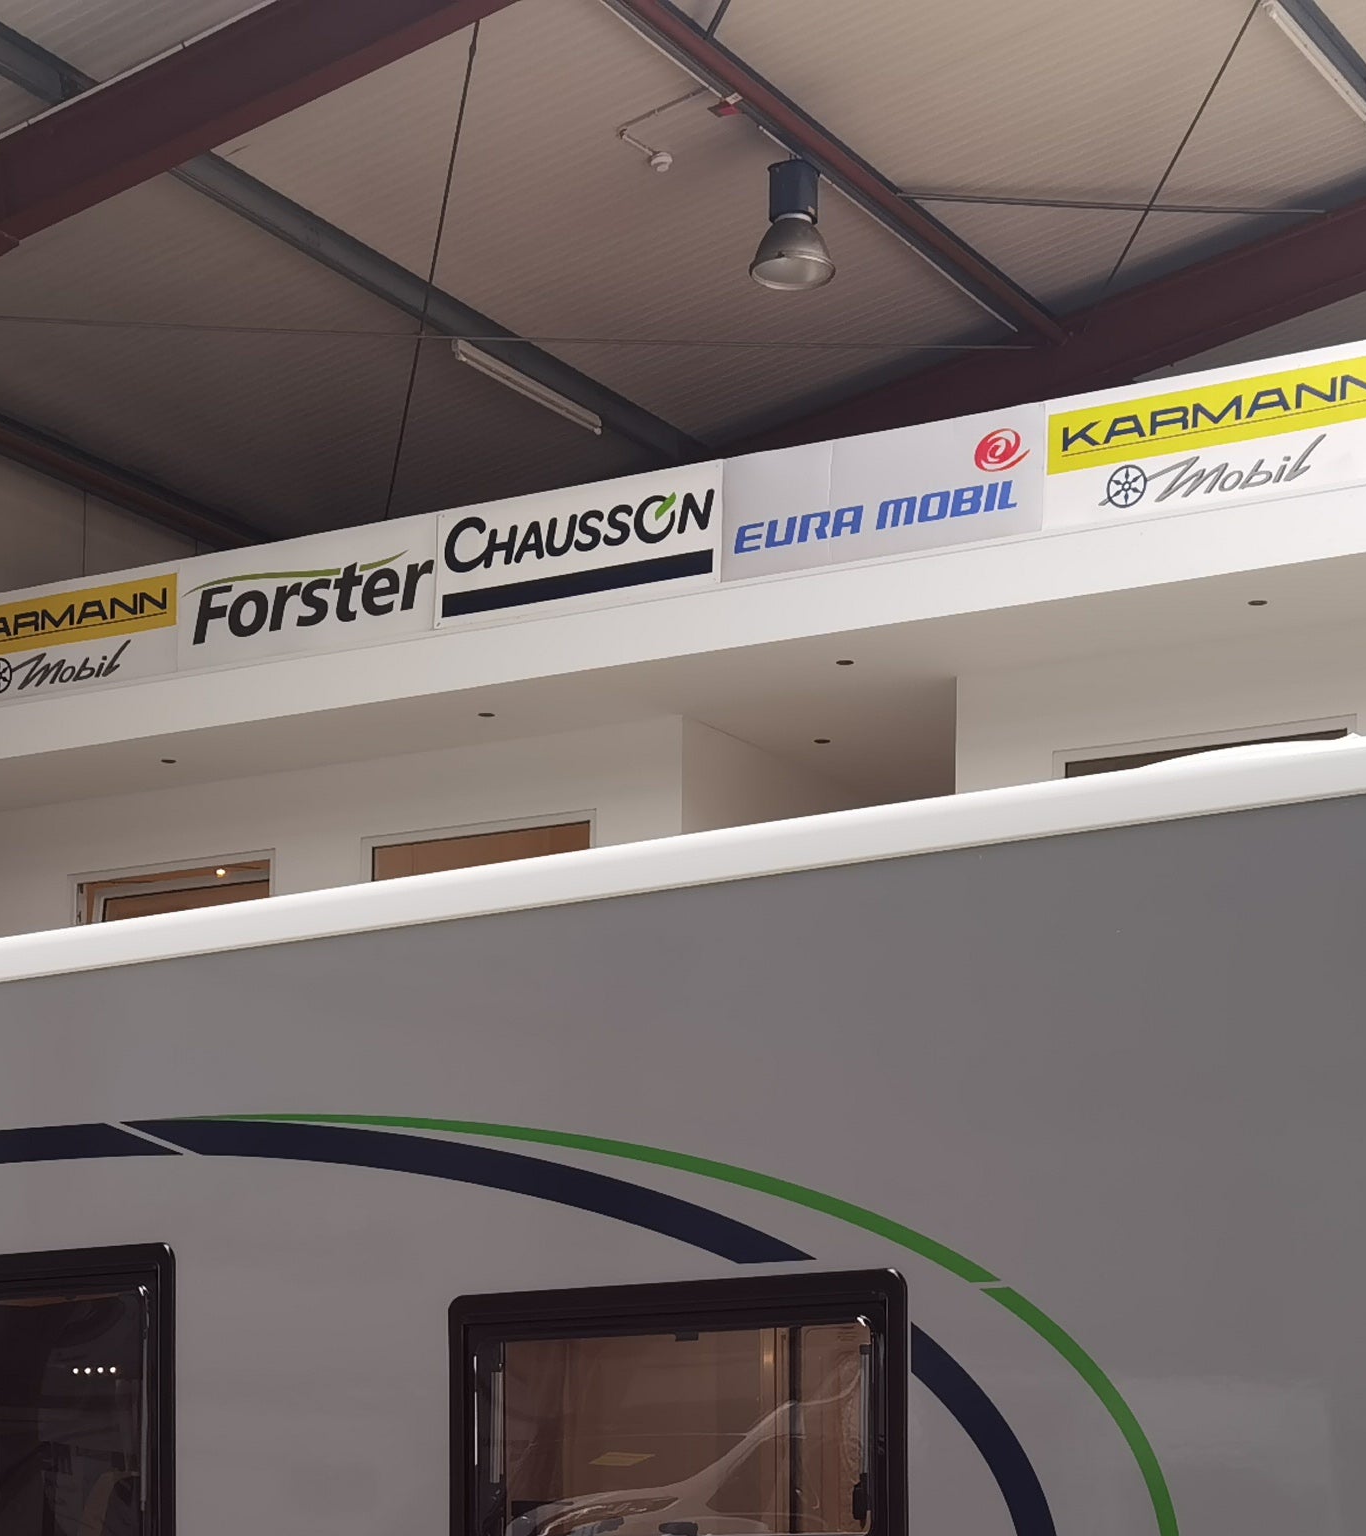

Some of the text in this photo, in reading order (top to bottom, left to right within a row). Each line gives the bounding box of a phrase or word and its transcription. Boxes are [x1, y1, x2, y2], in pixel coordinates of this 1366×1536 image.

[1154, 433, 1327, 503] Mobil
[444, 488, 715, 573] CHAUSSON
[733, 479, 1018, 555] EURA MOBIL
[192, 559, 434, 645] Forster
[17, 640, 132, 692] Mobil
